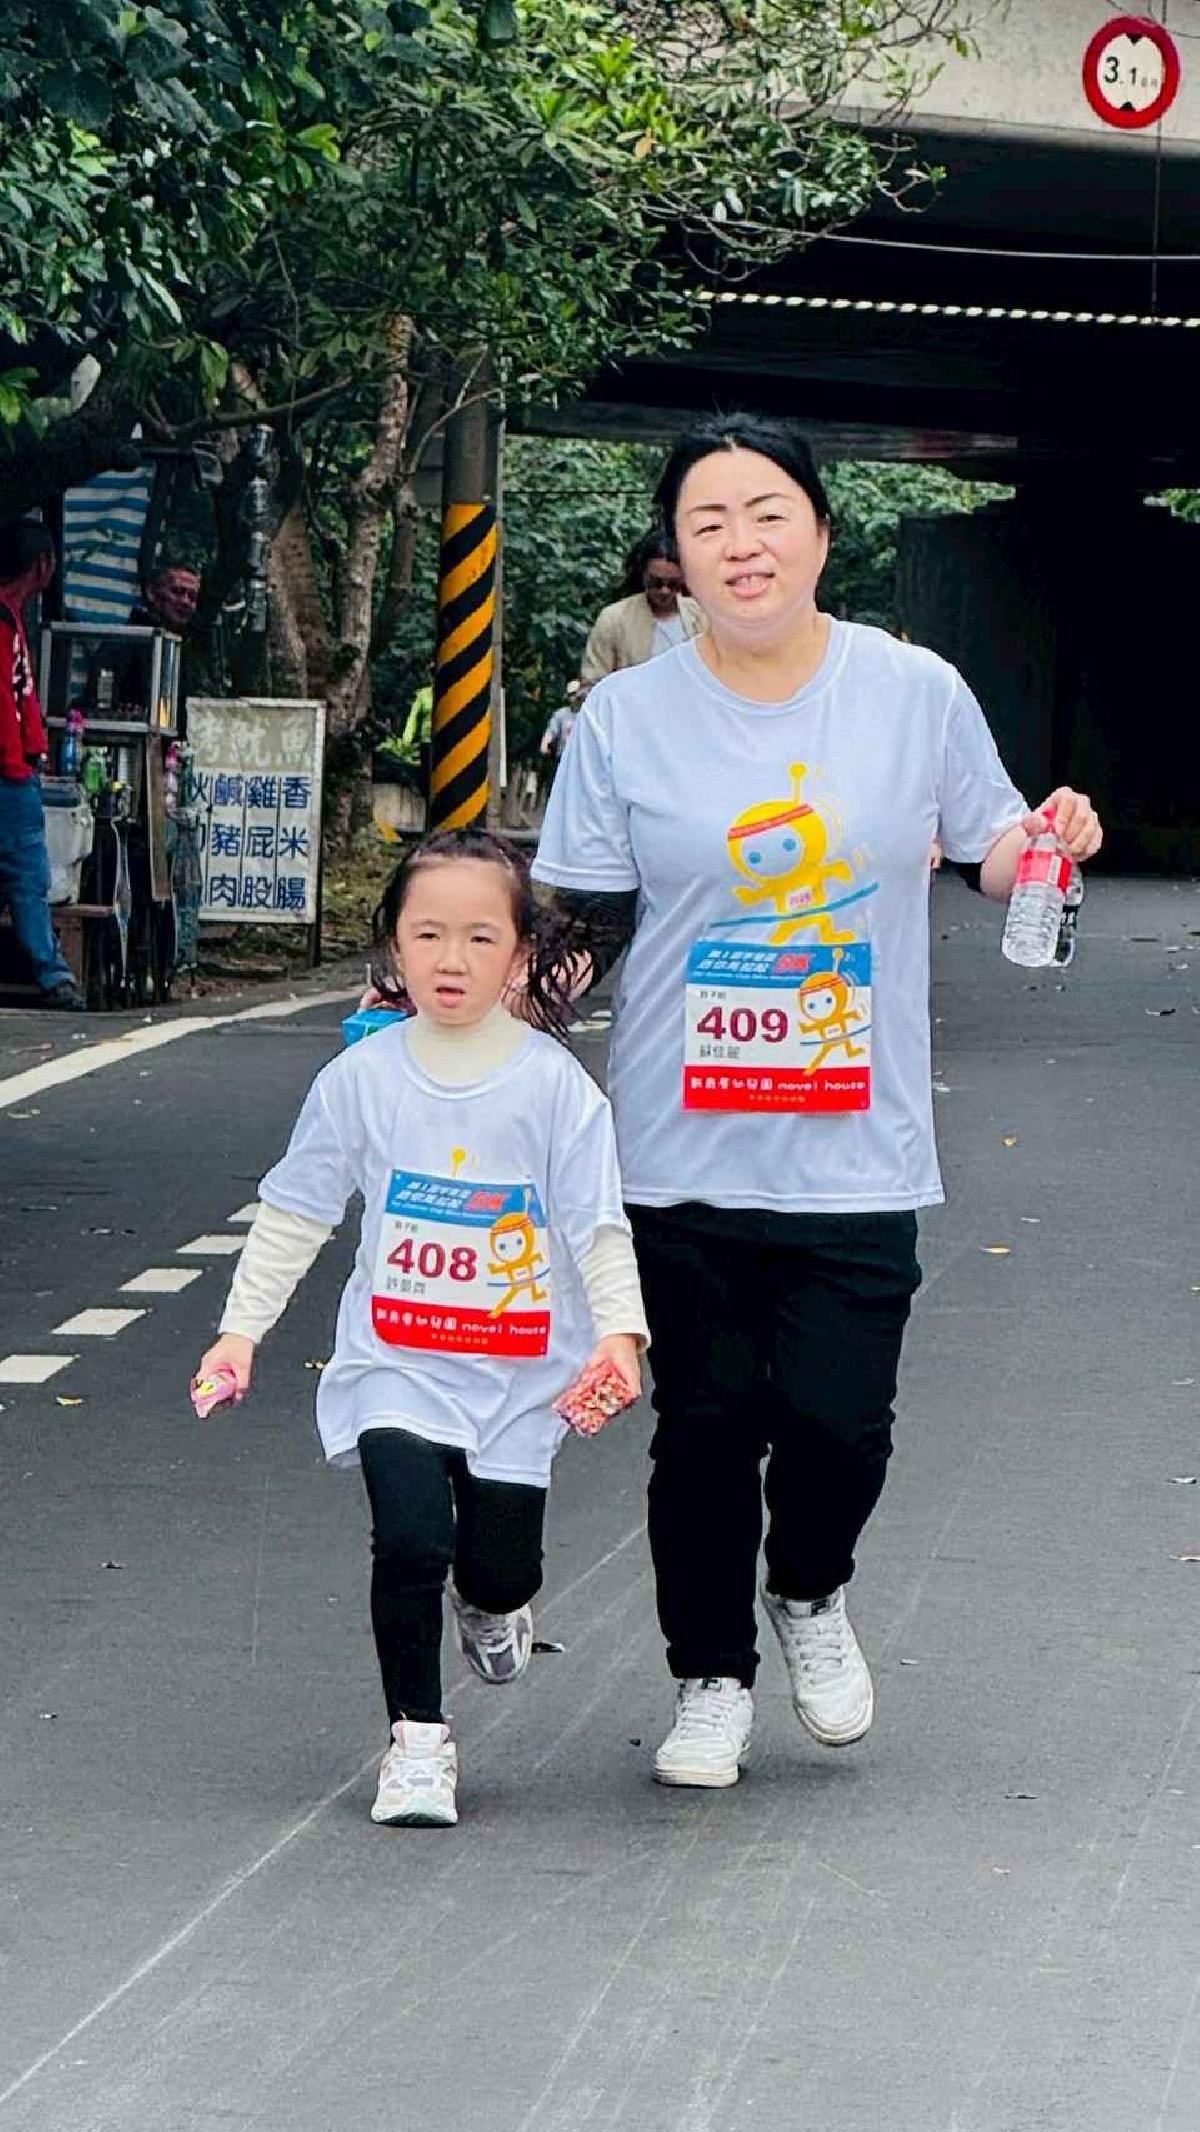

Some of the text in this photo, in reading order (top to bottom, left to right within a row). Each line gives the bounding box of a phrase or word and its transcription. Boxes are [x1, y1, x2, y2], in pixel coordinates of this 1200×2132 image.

[210, 772, 243, 907] 鹹豬肉
[241, 775, 277, 909] 雞屁股
[278, 776, 312, 910] 香米腸
[697, 1006, 789, 1043] 409
[778, 1080, 818, 1091] novel
[824, 1080, 866, 1091] house
[387, 1238, 478, 1282] 408
[461, 1322, 502, 1333] novel
[509, 1323, 547, 1335] house
